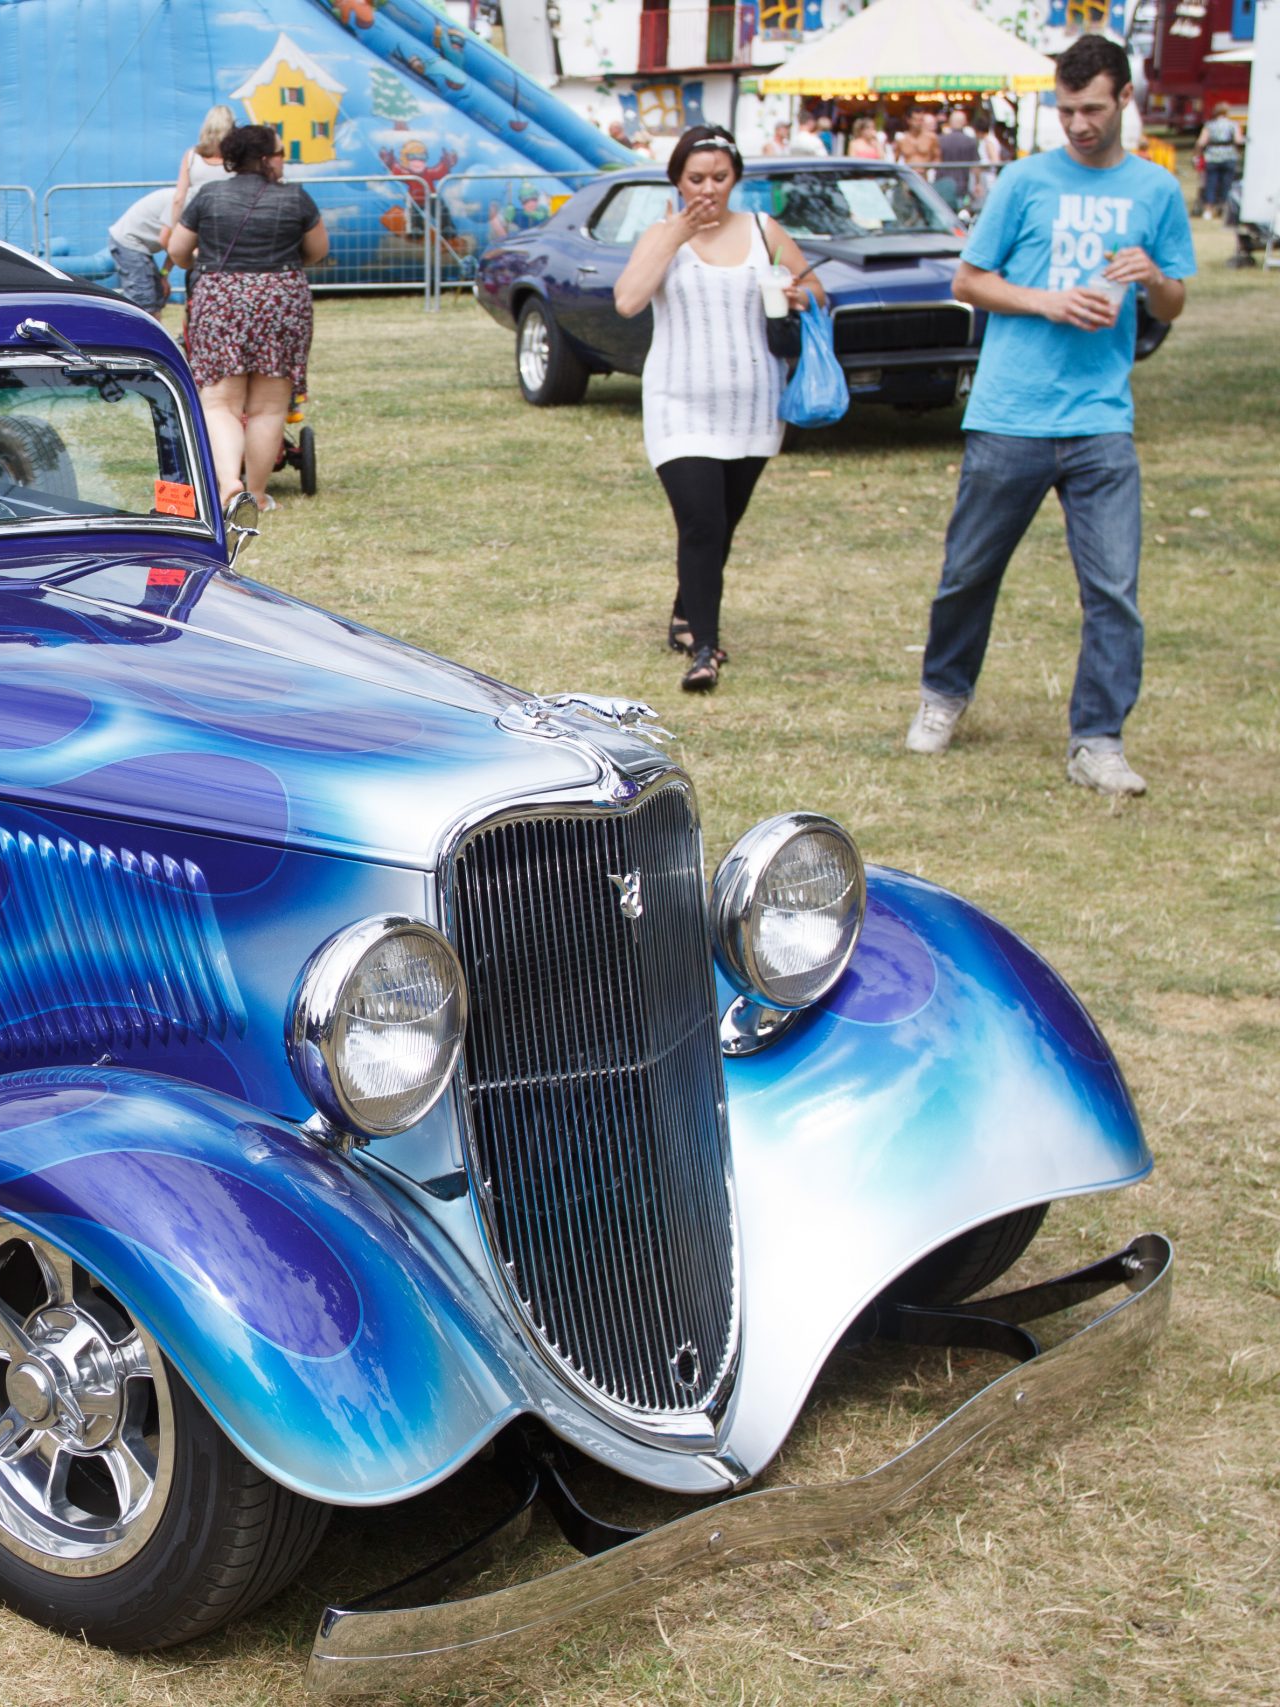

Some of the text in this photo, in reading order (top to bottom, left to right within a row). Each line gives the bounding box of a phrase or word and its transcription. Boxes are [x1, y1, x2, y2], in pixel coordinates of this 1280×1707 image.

[1052, 194, 1133, 235] JUST
[1051, 231, 1103, 270] DO
[1047, 267, 1081, 292] IT
